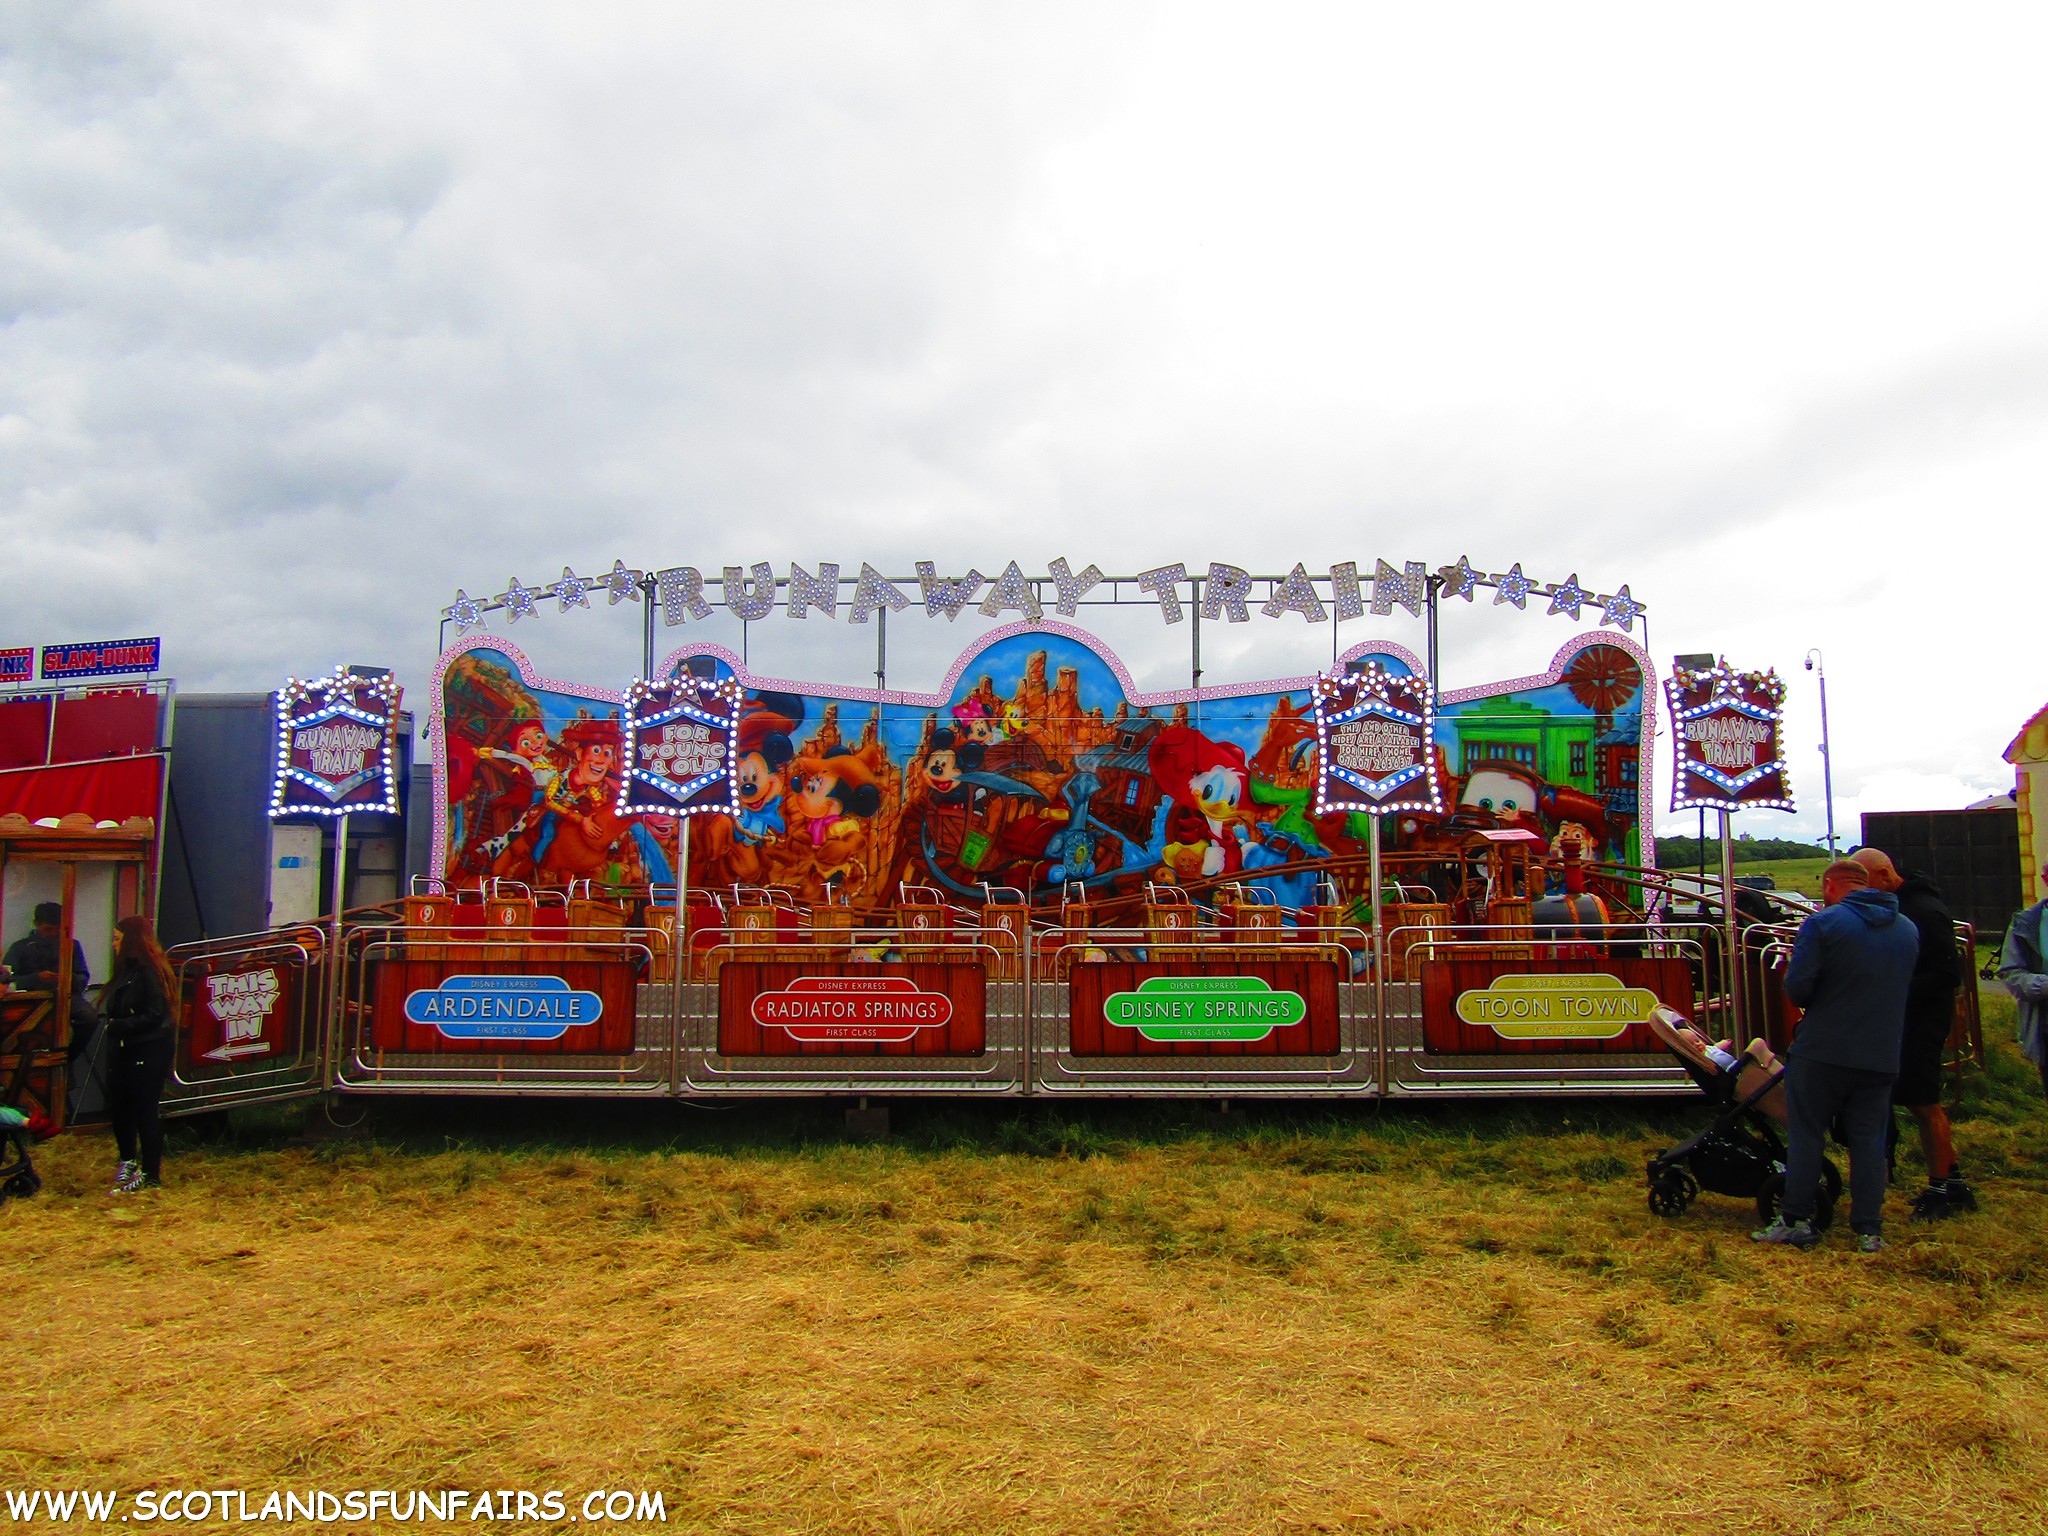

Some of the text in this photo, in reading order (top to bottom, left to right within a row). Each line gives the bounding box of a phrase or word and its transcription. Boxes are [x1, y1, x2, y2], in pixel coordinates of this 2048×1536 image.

[656, 556, 1426, 626] RUNAWAY TRAIN
[0, 656, 29, 674] NK
[44, 645, 156, 672] SLAM-DUNK
[294, 724, 383, 750] RUNAWAY
[662, 724, 710, 742] FOR
[1341, 721, 1409, 736] THIS AND OTHER
[1684, 716, 1771, 743] RUNAWAY
[1331, 734, 1419, 748] RIDES ARE AVAILABLE
[639, 741, 726, 760] YOUNG
[1341, 745, 1357, 755] FOR
[1382, 746, 1410, 757] PHONE
[1701, 741, 1755, 768] TRAIN
[310, 749, 365, 775] TRAIN
[651, 758, 720, 775] & OLD
[207, 968, 279, 1000] THIS
[471, 980, 500, 988] DISNEY
[818, 982, 887, 990] DISNEY EXPRESS
[1170, 982, 1239, 990] DISNEY EXPRESS
[207, 992, 281, 1021] WAY
[424, 997, 581, 1019] ARDENDALE
[766, 1001, 938, 1019] RADIATOR SPRINGS
[1121, 1001, 1290, 1018] DISNEY SPRINGS
[1476, 997, 1638, 1017] TOON TOWN
[226, 1014, 263, 1042] IN
[502, 1027, 527, 1035] CLASS
